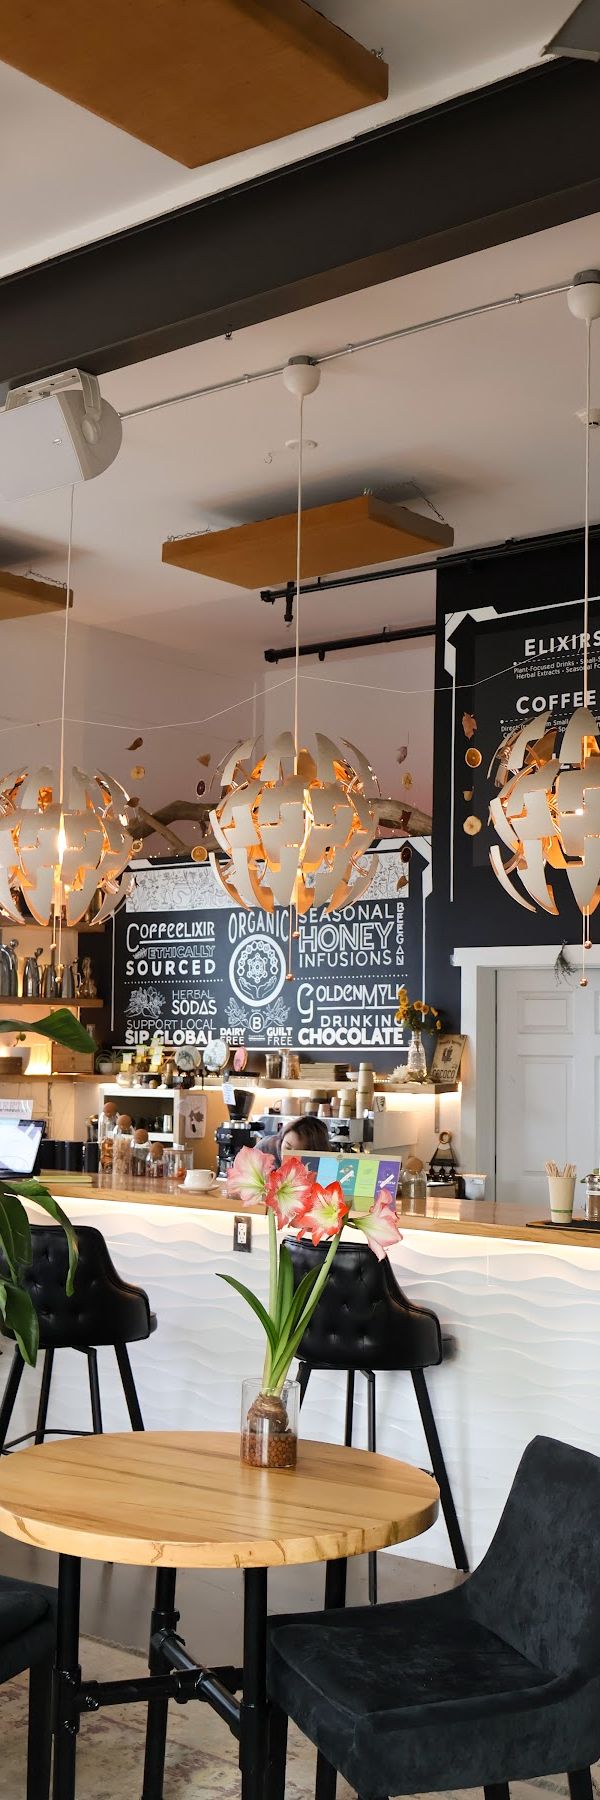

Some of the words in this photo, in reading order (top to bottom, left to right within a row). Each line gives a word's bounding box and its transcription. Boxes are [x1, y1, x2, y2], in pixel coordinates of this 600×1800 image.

[524, 630, 600, 656] ELIXIRS
[513, 661, 555, 674] Plant-Focused
[556, 659, 575, 669] Drinks
[516, 671, 536, 680] Herbal
[537, 669, 560, 677] Extracts
[565, 663, 593, 673] Seasoal
[516, 689, 596, 714] COFFEE
[299, 903, 394, 924] SEASONAL
[228, 909, 289, 944] ORGANIC
[299, 921, 394, 953] HONEY
[148, 945, 216, 959] ETHICALLY
[299, 949, 392, 969] INFUSIONS
[125, 959, 216, 976] SOURCED
[172, 989, 215, 1000] HERBAL
[171, 999, 218, 1016] SODAS
[126, 1019, 178, 1030] SUPPORT
[180, 1018, 217, 1030] LOCAL
[220, 1027, 247, 1036] DAIRY
[266, 1026, 293, 1037] GUILT
[125, 1029, 150, 1045] SIP
[267, 1036, 293, 1046] FREE
[297, 1027, 404, 1046] CHOCOLATE
